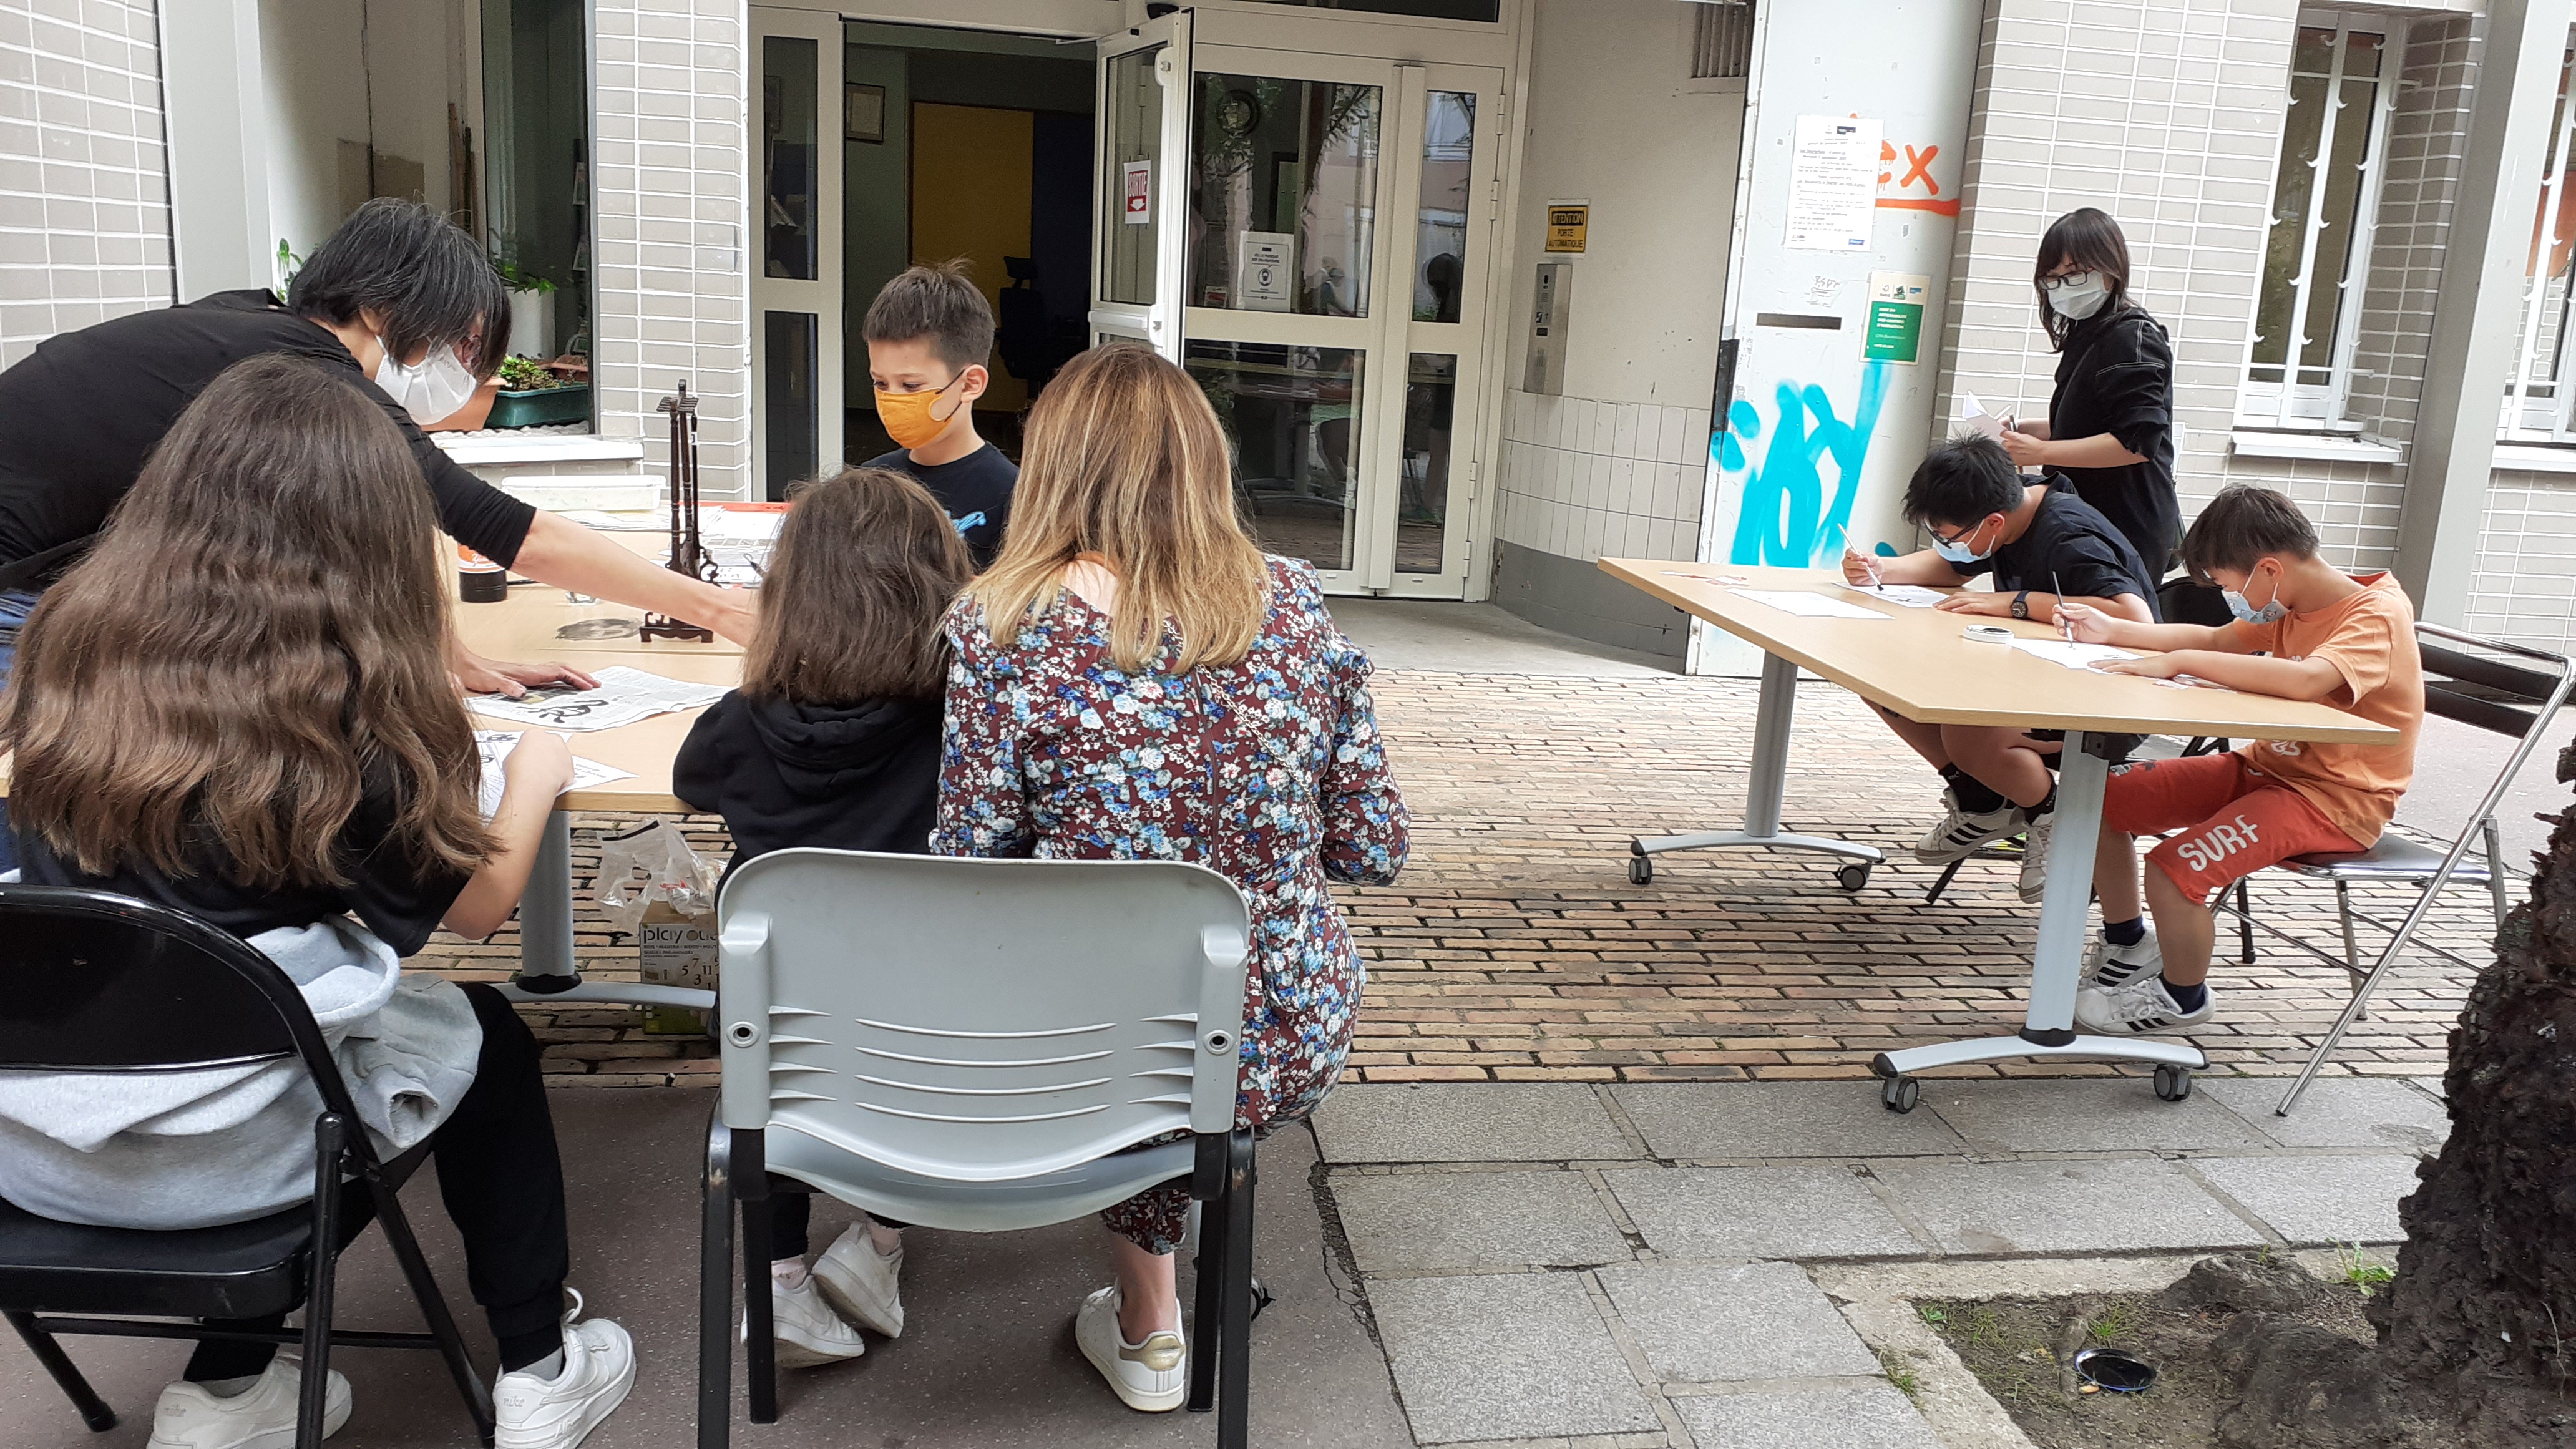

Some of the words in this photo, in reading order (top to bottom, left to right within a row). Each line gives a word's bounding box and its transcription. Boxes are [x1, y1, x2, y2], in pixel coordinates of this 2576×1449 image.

[1128, 172, 1148, 197] SORTIE
[1552, 213, 1583, 224] ATTENTION
[1557, 228, 1574, 237] PORTE
[1548, 239, 1583, 248] AUTOMATIQUE
[2177, 814, 2260, 872] SURF
[643, 927, 683, 944] play
[692, 957, 699, 968] 7
[681, 965, 689, 977] 5
[702, 965, 712, 975] 11
[694, 973, 701, 985] 3
